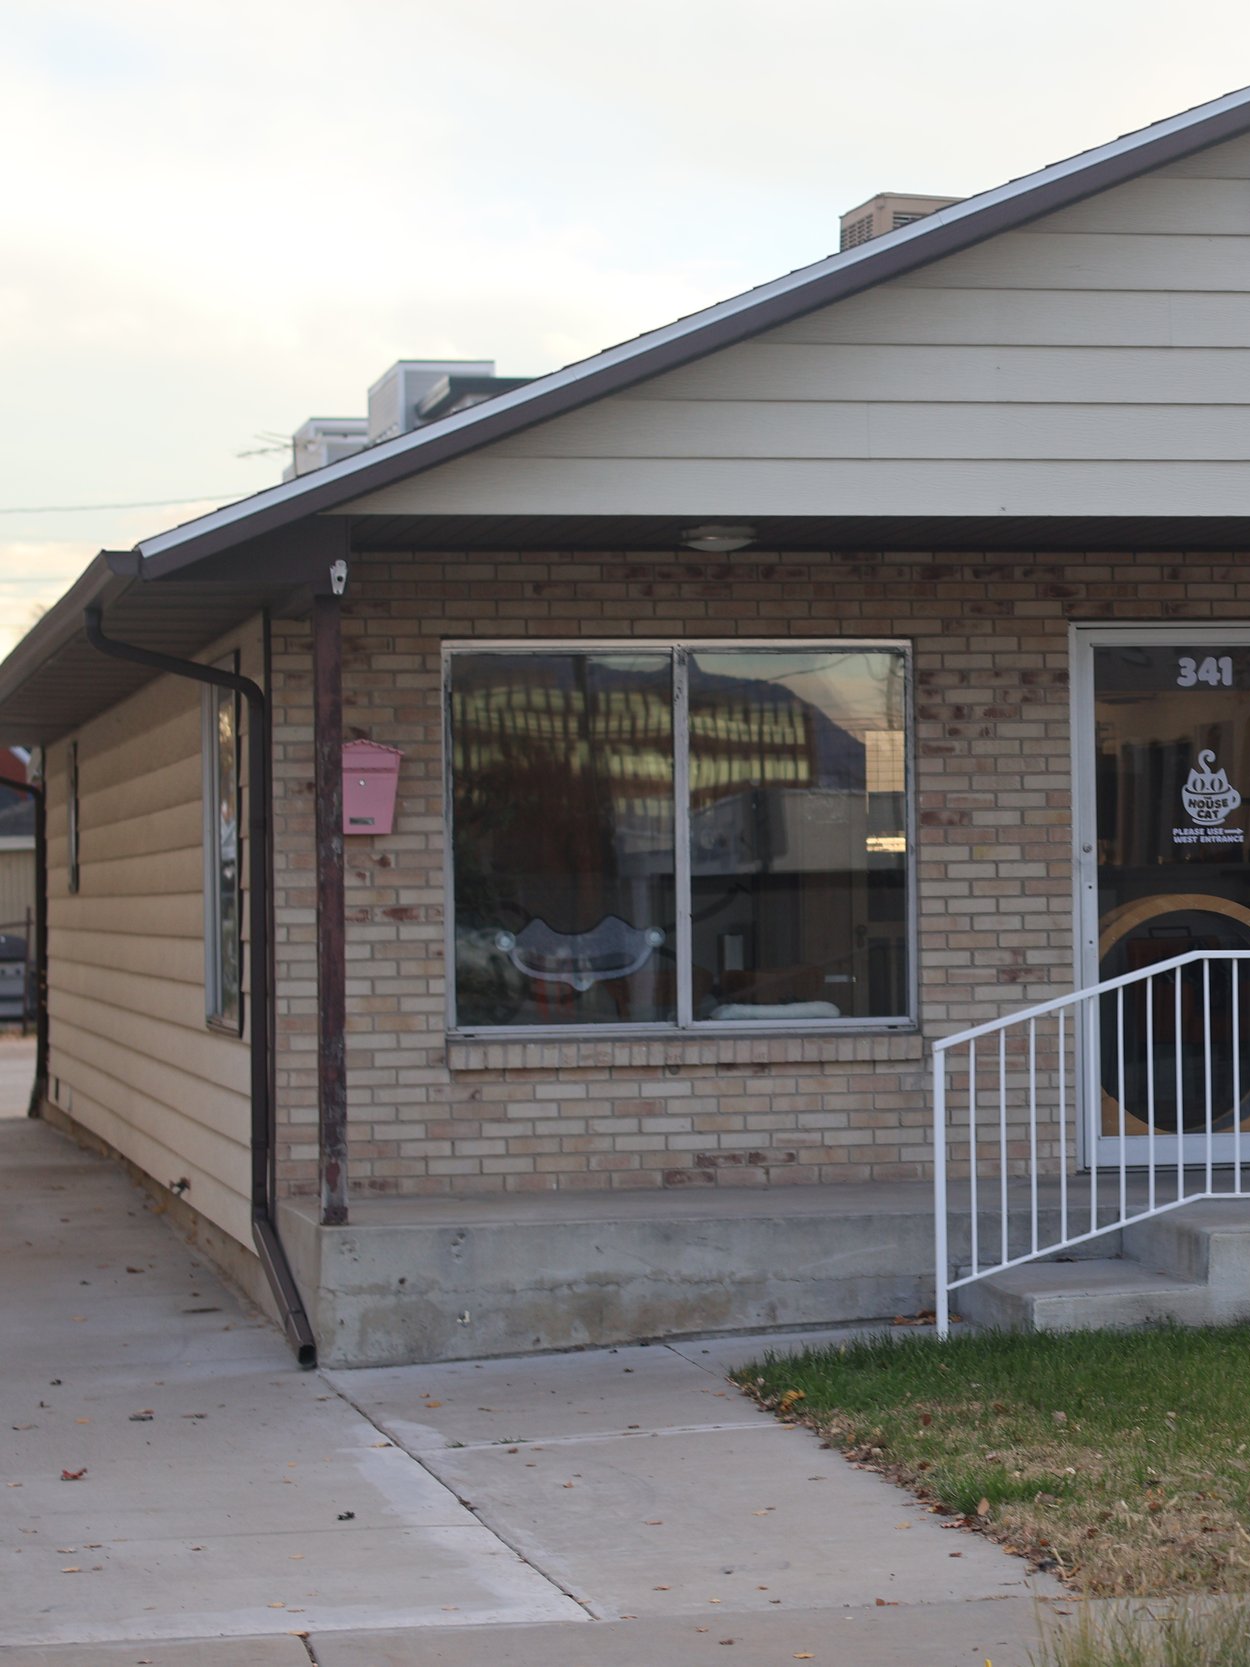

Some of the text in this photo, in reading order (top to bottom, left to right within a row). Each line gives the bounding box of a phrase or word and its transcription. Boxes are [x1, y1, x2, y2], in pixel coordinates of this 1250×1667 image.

[1176, 656, 1233, 687] 341
[1188, 798, 1229, 809] HOUSE
[1197, 809, 1219, 819] CAT
[1200, 835, 1244, 843] ENTRANCE
